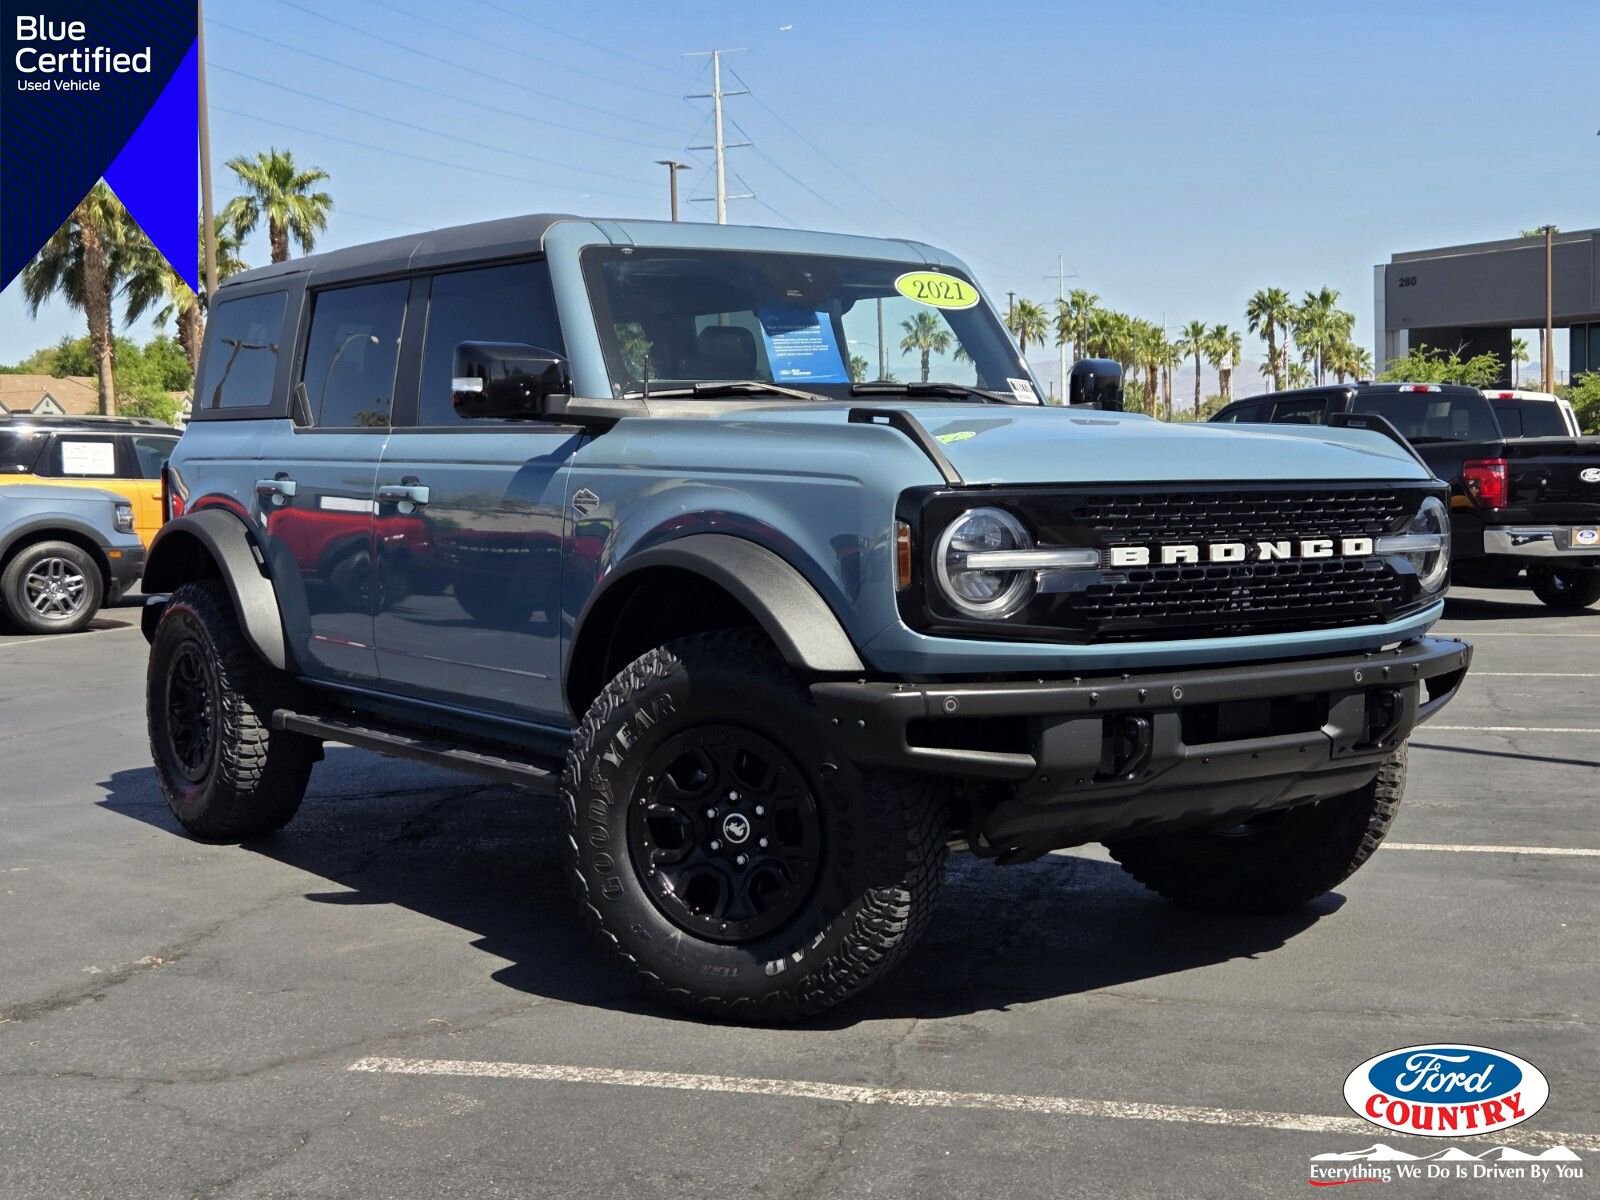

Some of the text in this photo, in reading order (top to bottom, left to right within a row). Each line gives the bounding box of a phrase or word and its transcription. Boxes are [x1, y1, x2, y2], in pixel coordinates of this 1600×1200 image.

[912, 279, 966, 301] 2021
[1399, 276, 1417, 288] 280
[1110, 538, 1373, 566] BRONCO
